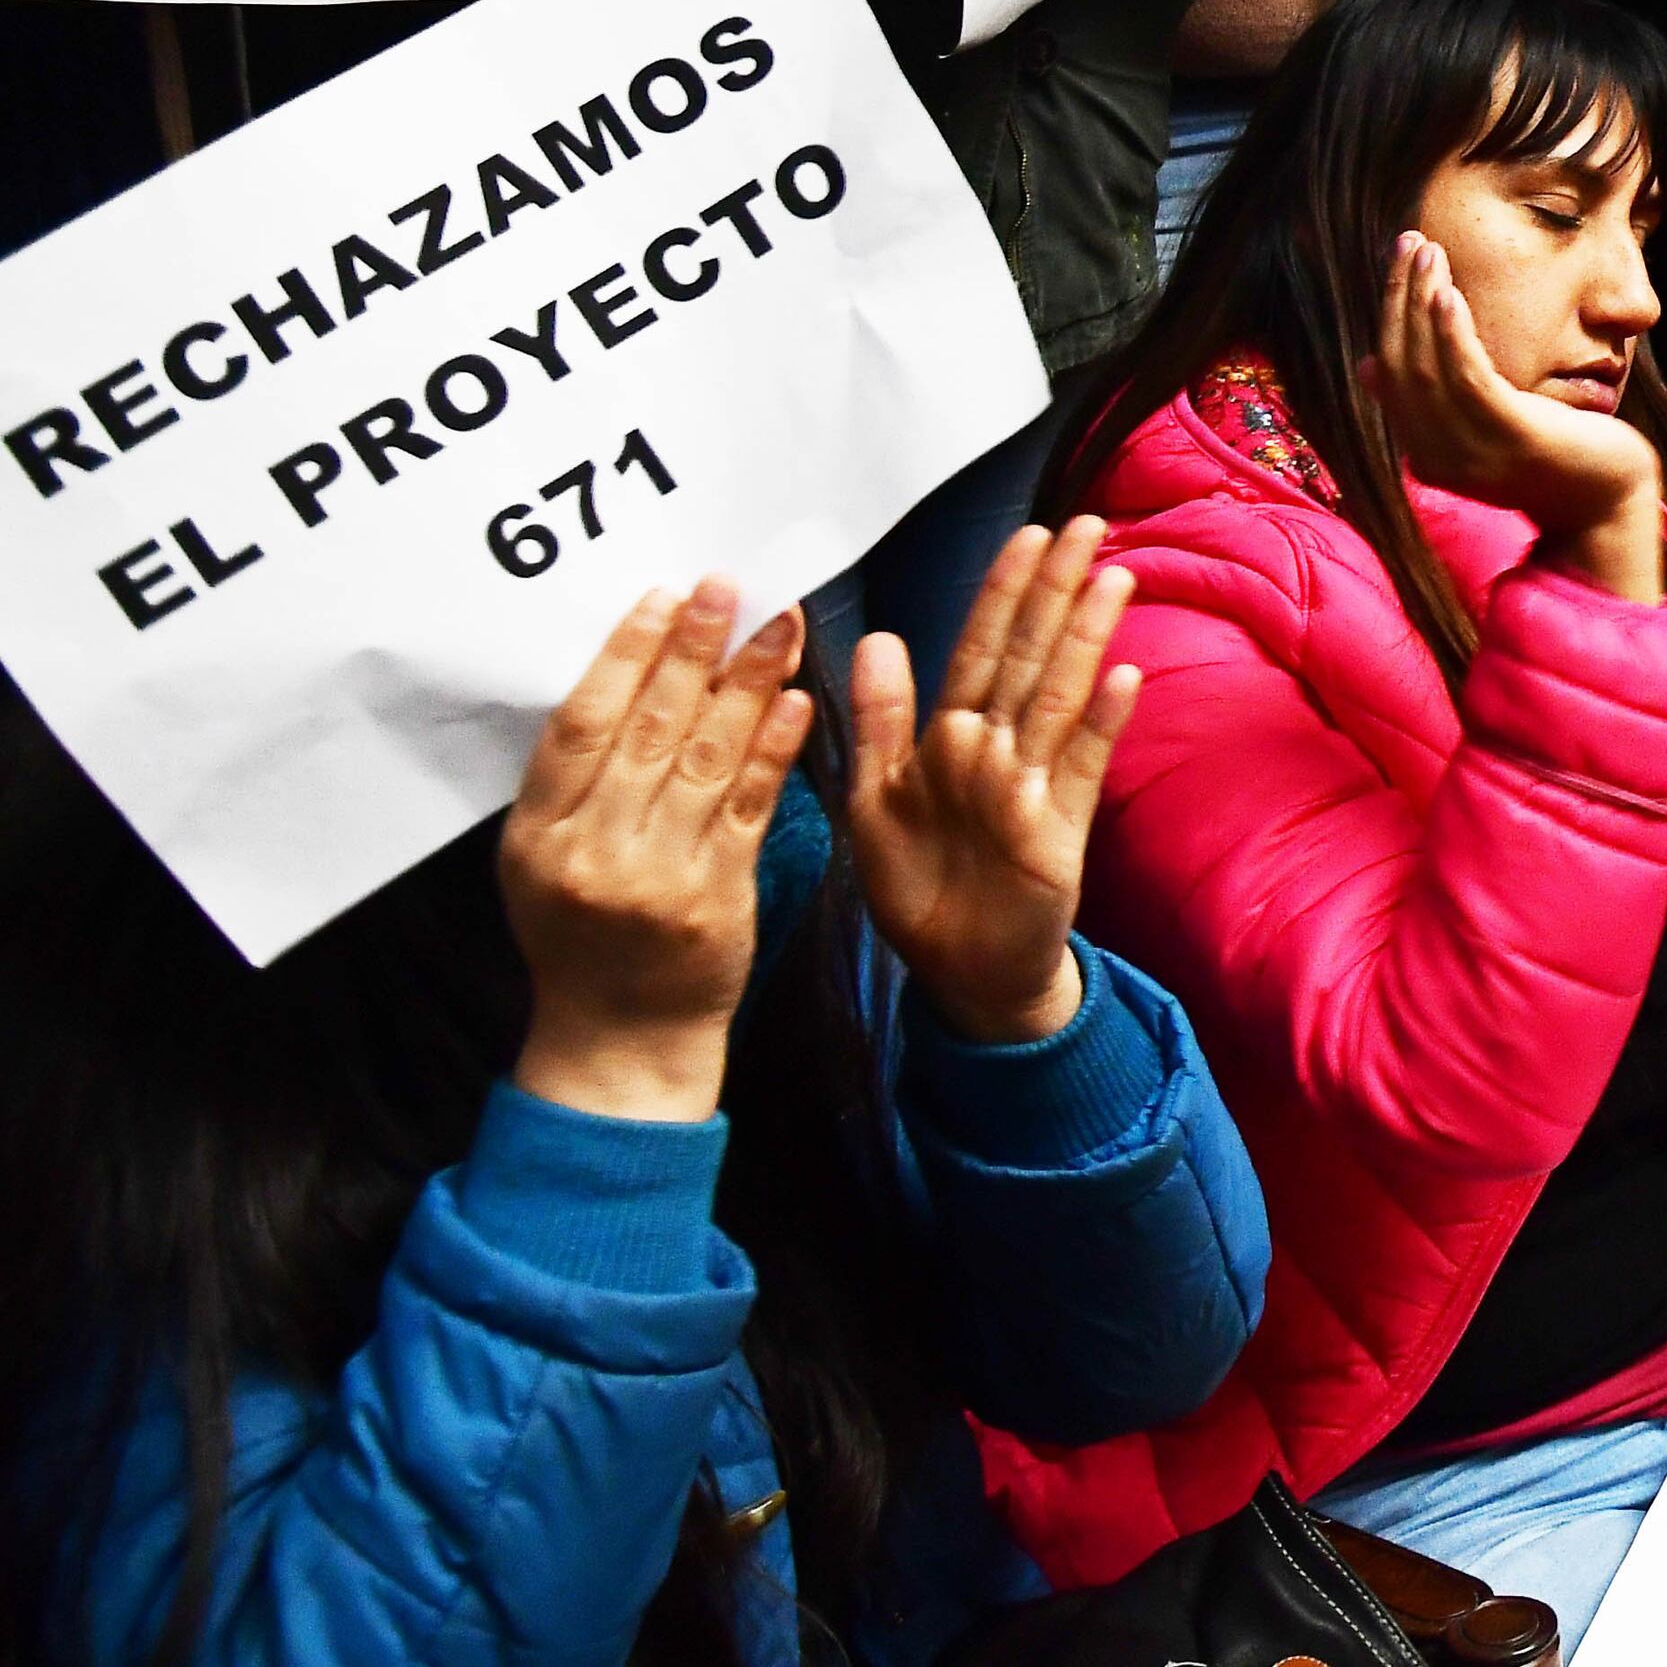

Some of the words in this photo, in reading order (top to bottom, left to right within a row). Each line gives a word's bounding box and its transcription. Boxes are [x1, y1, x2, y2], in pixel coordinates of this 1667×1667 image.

[2, 14, 775, 498] RECHAZAMOS
[97, 516, 263, 631] EL
[267, 143, 847, 528] PROYECTO
[484, 428, 681, 580] 671
